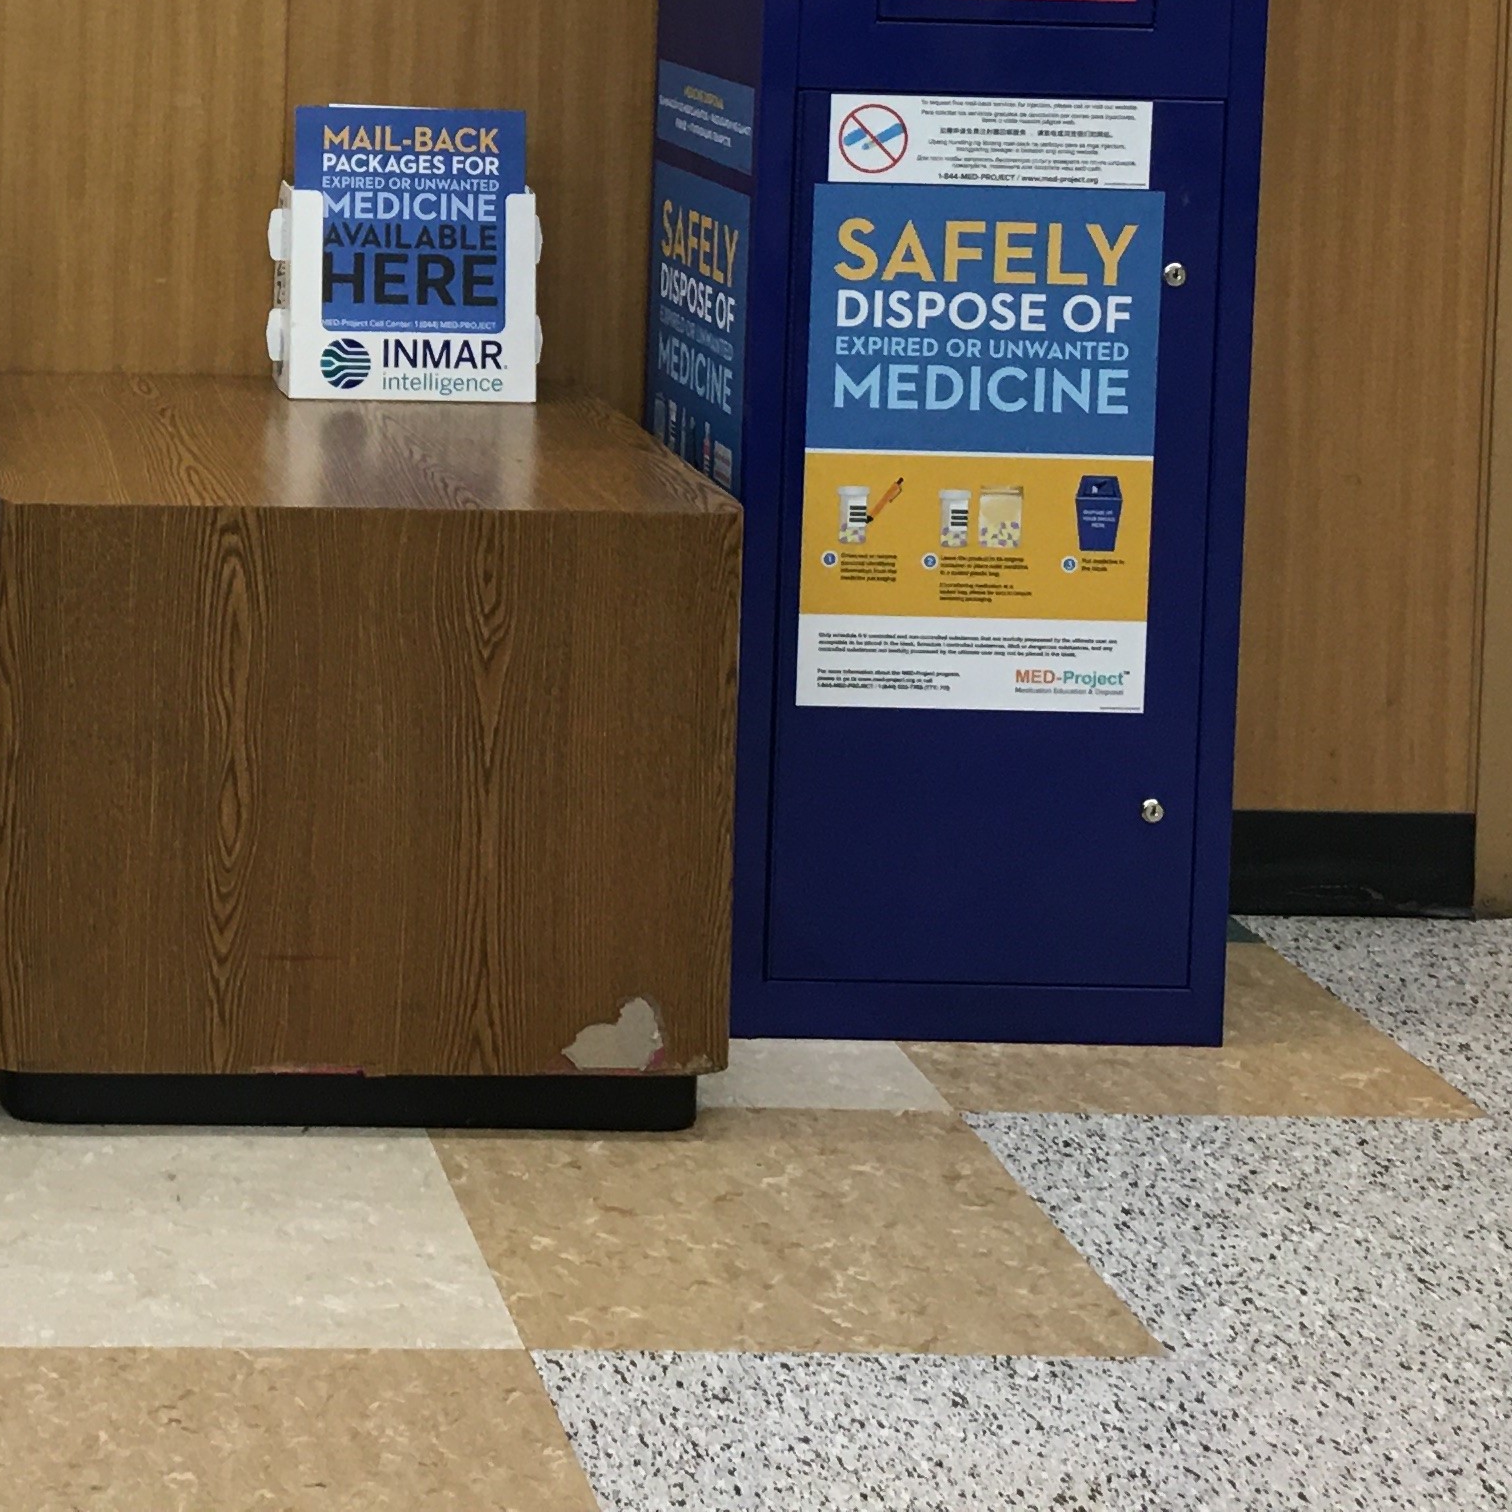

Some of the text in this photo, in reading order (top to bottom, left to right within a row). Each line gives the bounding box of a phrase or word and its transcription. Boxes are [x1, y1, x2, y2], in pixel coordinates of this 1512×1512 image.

[323, 124, 499, 153] MAIL-BACK
[322, 152, 499, 175] PACKAGES FOR
[322, 175, 499, 191] EXPIRED OR UNWANTED
[323, 191, 496, 221] MEDICINE
[324, 222, 497, 251] AVAILABLE
[661, 199, 738, 287] SAFELY
[833, 217, 1138, 286] SAFELY
[324, 251, 498, 306] HERE
[660, 262, 713, 322] DISPOSE
[715, 292, 735, 332] OF
[836, 289, 1132, 333] DISPOSE OF
[383, 338, 502, 369] INMAR
[835, 335, 1128, 361] EXPIRED OR UNWANTED
[382, 372, 503, 395] intelligence
[658, 334, 732, 414] MEDICINE
[833, 362, 1129, 414] MEDICINE
[1094, 688, 1123, 696] Disposal
